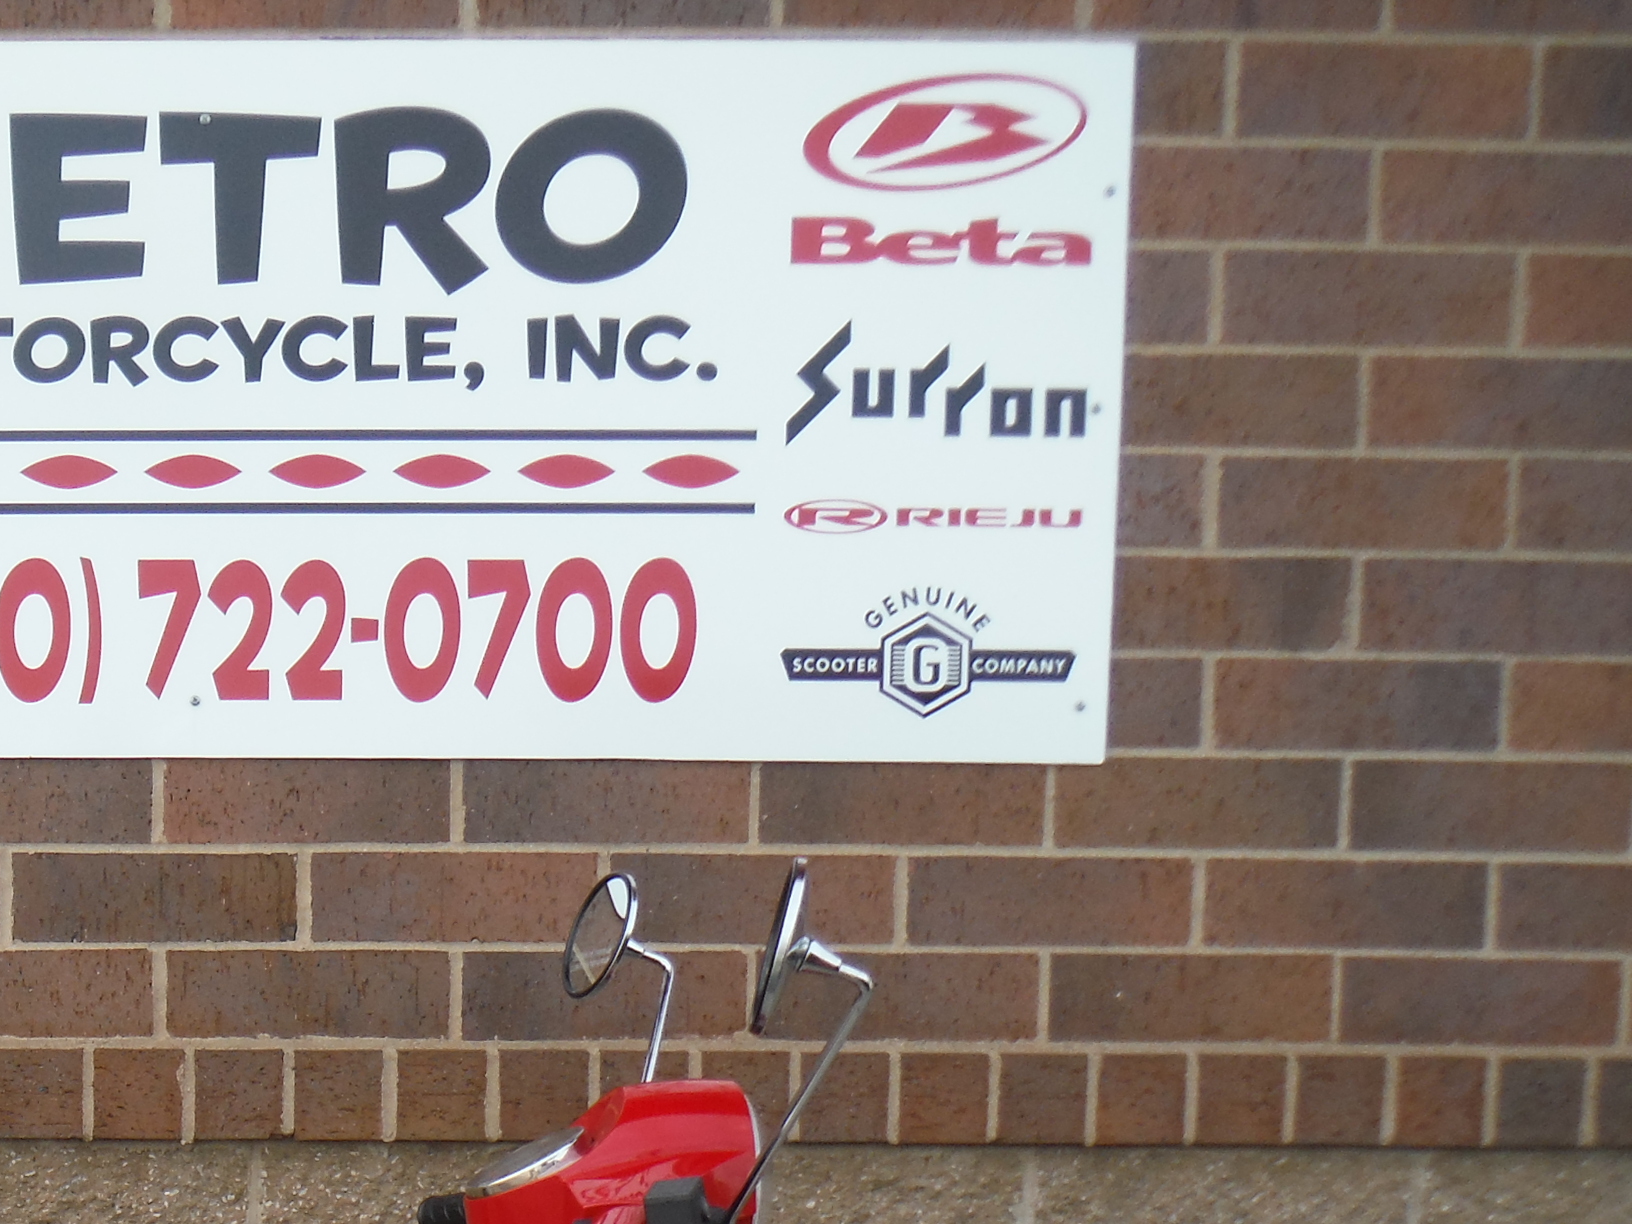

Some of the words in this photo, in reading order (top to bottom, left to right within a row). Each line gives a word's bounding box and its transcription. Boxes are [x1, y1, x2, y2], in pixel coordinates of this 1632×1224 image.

[790, 216, 1093, 266] Beta
[527, 315, 718, 382] INC.
[895, 507, 1084, 528] RIEJU
[137, 557, 698, 703] 722-0700
[864, 586, 991, 633] GENUINE
[792, 657, 879, 674] SCOOTER
[912, 644, 941, 686] G
[971, 657, 1067, 675] COMPANY
